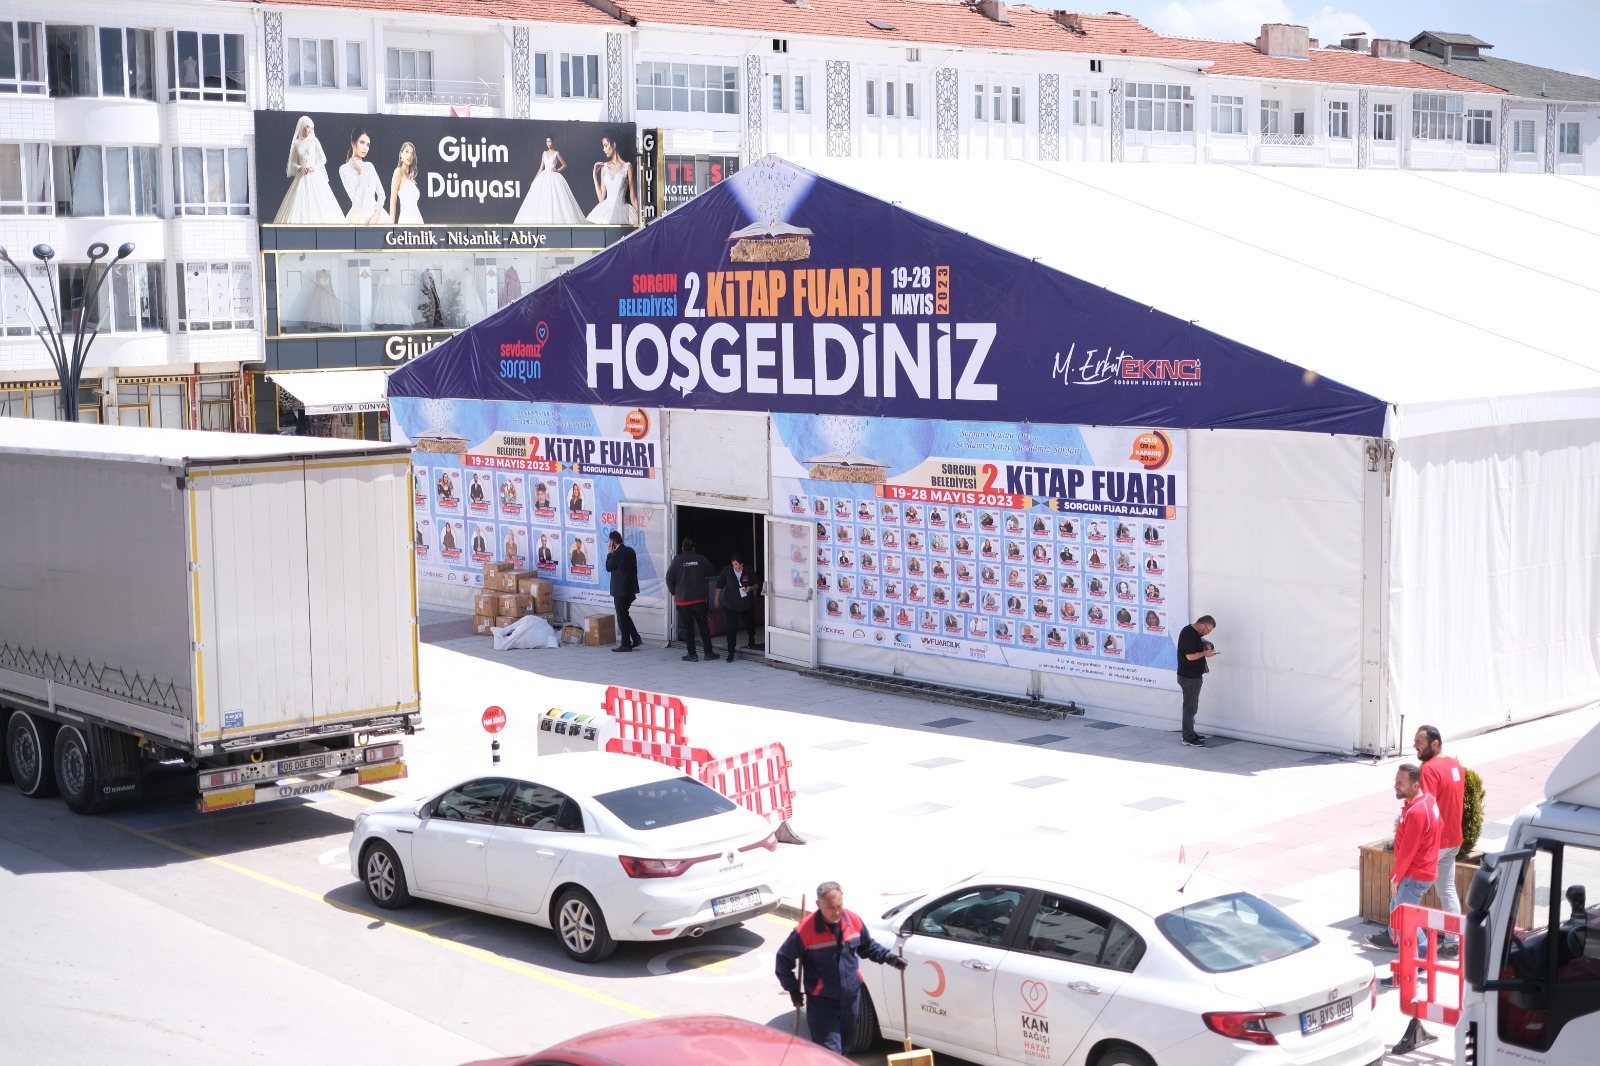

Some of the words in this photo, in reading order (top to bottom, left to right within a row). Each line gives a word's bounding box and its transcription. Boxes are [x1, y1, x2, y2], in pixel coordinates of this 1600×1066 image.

[438, 136, 509, 163] Giyim
[427, 171, 521, 203] Dünyası
[385, 231, 437, 247] Gelinlik
[447, 231, 501, 249] Nişanlık
[633, 273, 678, 293] SORGUN
[890, 266, 931, 289] 19-28
[684, 271, 705, 318] 2.
[793, 267, 881, 317] FUARI
[936, 266, 949, 313] 2023
[618, 294, 678, 317] BELEDİYESİ
[891, 293, 934, 316] MAYIS
[500, 341, 541, 359] sevdamız
[500, 359, 541, 382] sorgun
[1079, 347, 1133, 382] Erkut
[332, 403, 354, 412] GİYİM
[503, 436, 526, 446] SORGUN
[496, 446, 527, 457] BELEDİYESİ
[600, 440, 654, 468] FUARI
[471, 456, 495, 467] 19-28
[496, 458, 525, 470] MAYIS
[527, 460, 550, 471] 2023
[582, 465, 607, 474] SORGUN
[608, 467, 623, 475] FUAR
[624, 468, 644, 477] ALANI
[941, 463, 976, 476] SORGUN
[931, 475, 977, 489] BELEDİYESİ
[982, 463, 1005, 493] 2.
[1091, 470, 1176, 506] FUARI
[892, 487, 927, 500] 19-28
[930, 489, 976, 504] MAYIS
[978, 494, 1013, 507] 2023
[1064, 502, 1102, 512] SORGUN
[1103, 505, 1128, 513] FUAR
[1129, 506, 1158, 515] ALANI
[283, 761, 293, 771] 06
[310, 757, 324, 768] 855
[111, 784, 136, 793] KRONE
[293, 781, 336, 796] KRONE
[921, 1004, 947, 1016] KIZILAY
[1306, 1013, 1317, 1028] 34
[1320, 1006, 1335, 1024] BYS
[1337, 1000, 1351, 1017] 069
[1021, 1015, 1049, 1034] KAN
[1023, 1030, 1050, 1045] BAĞIŞI
[1024, 1041, 1051, 1054] HAYAT
